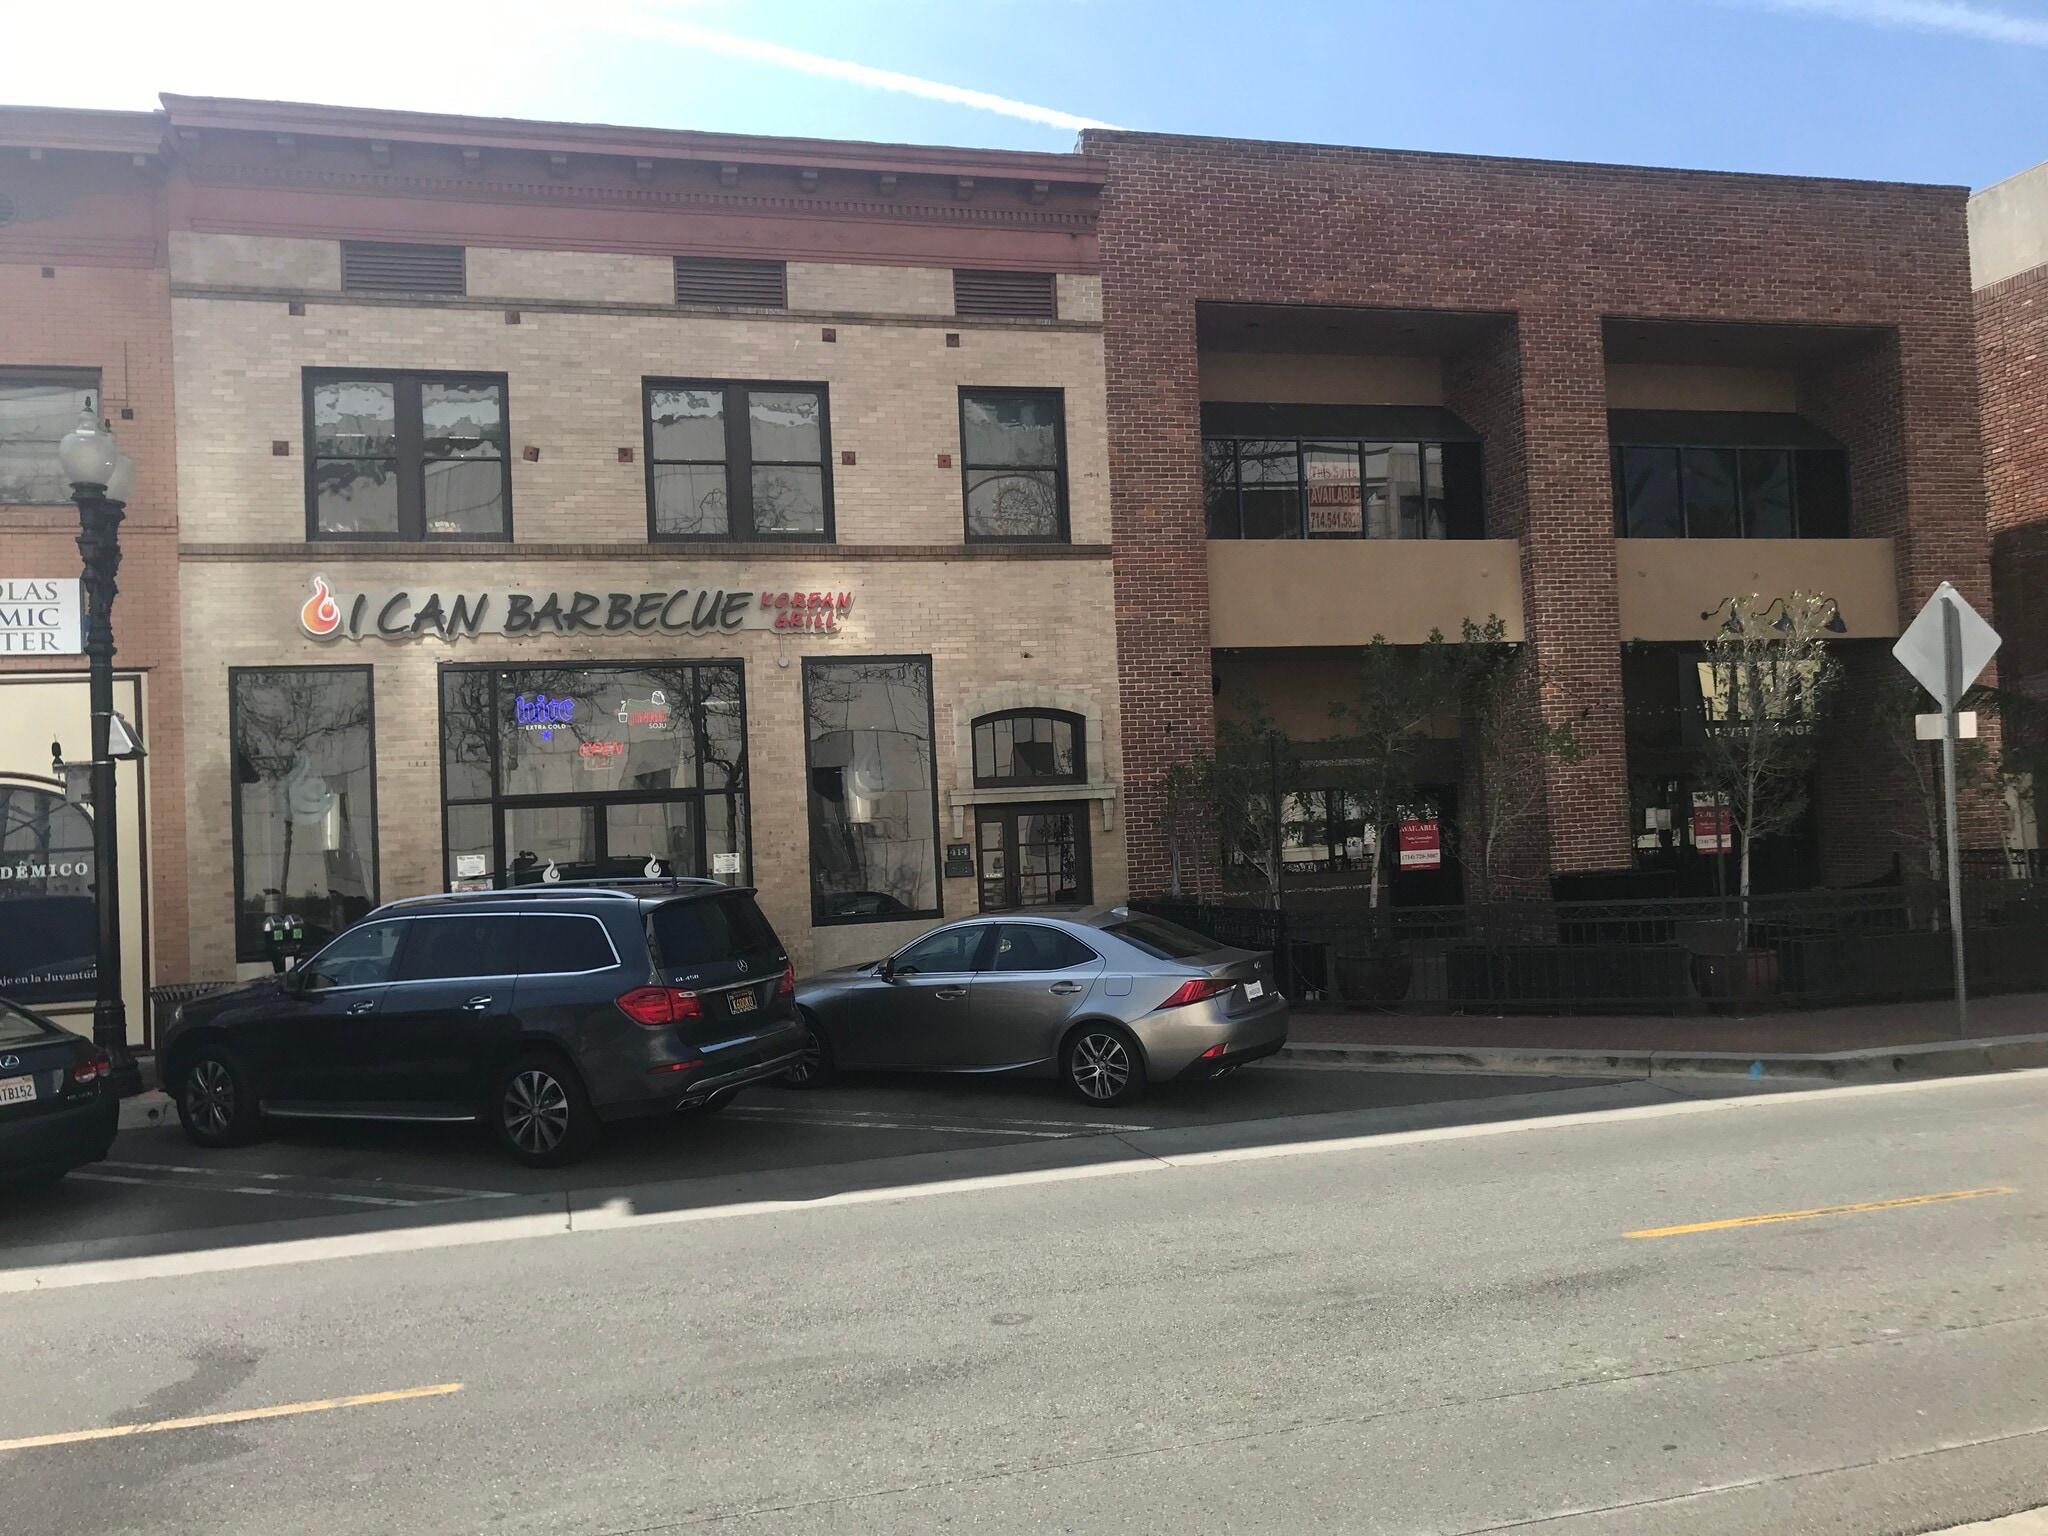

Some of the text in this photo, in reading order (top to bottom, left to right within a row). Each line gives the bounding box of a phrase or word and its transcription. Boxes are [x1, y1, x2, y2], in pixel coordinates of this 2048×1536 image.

[1311, 486, 1360, 504] AVAILABLE
[0, 581, 58, 600] LAS
[759, 591, 852, 611] KOREAN
[350, 590, 753, 635] I CAN BARBECUE
[774, 611, 838, 629] GRILL
[515, 694, 575, 723] hite
[579, 741, 624, 757] OPEN
[0, 1084, 33, 1101] TB152
